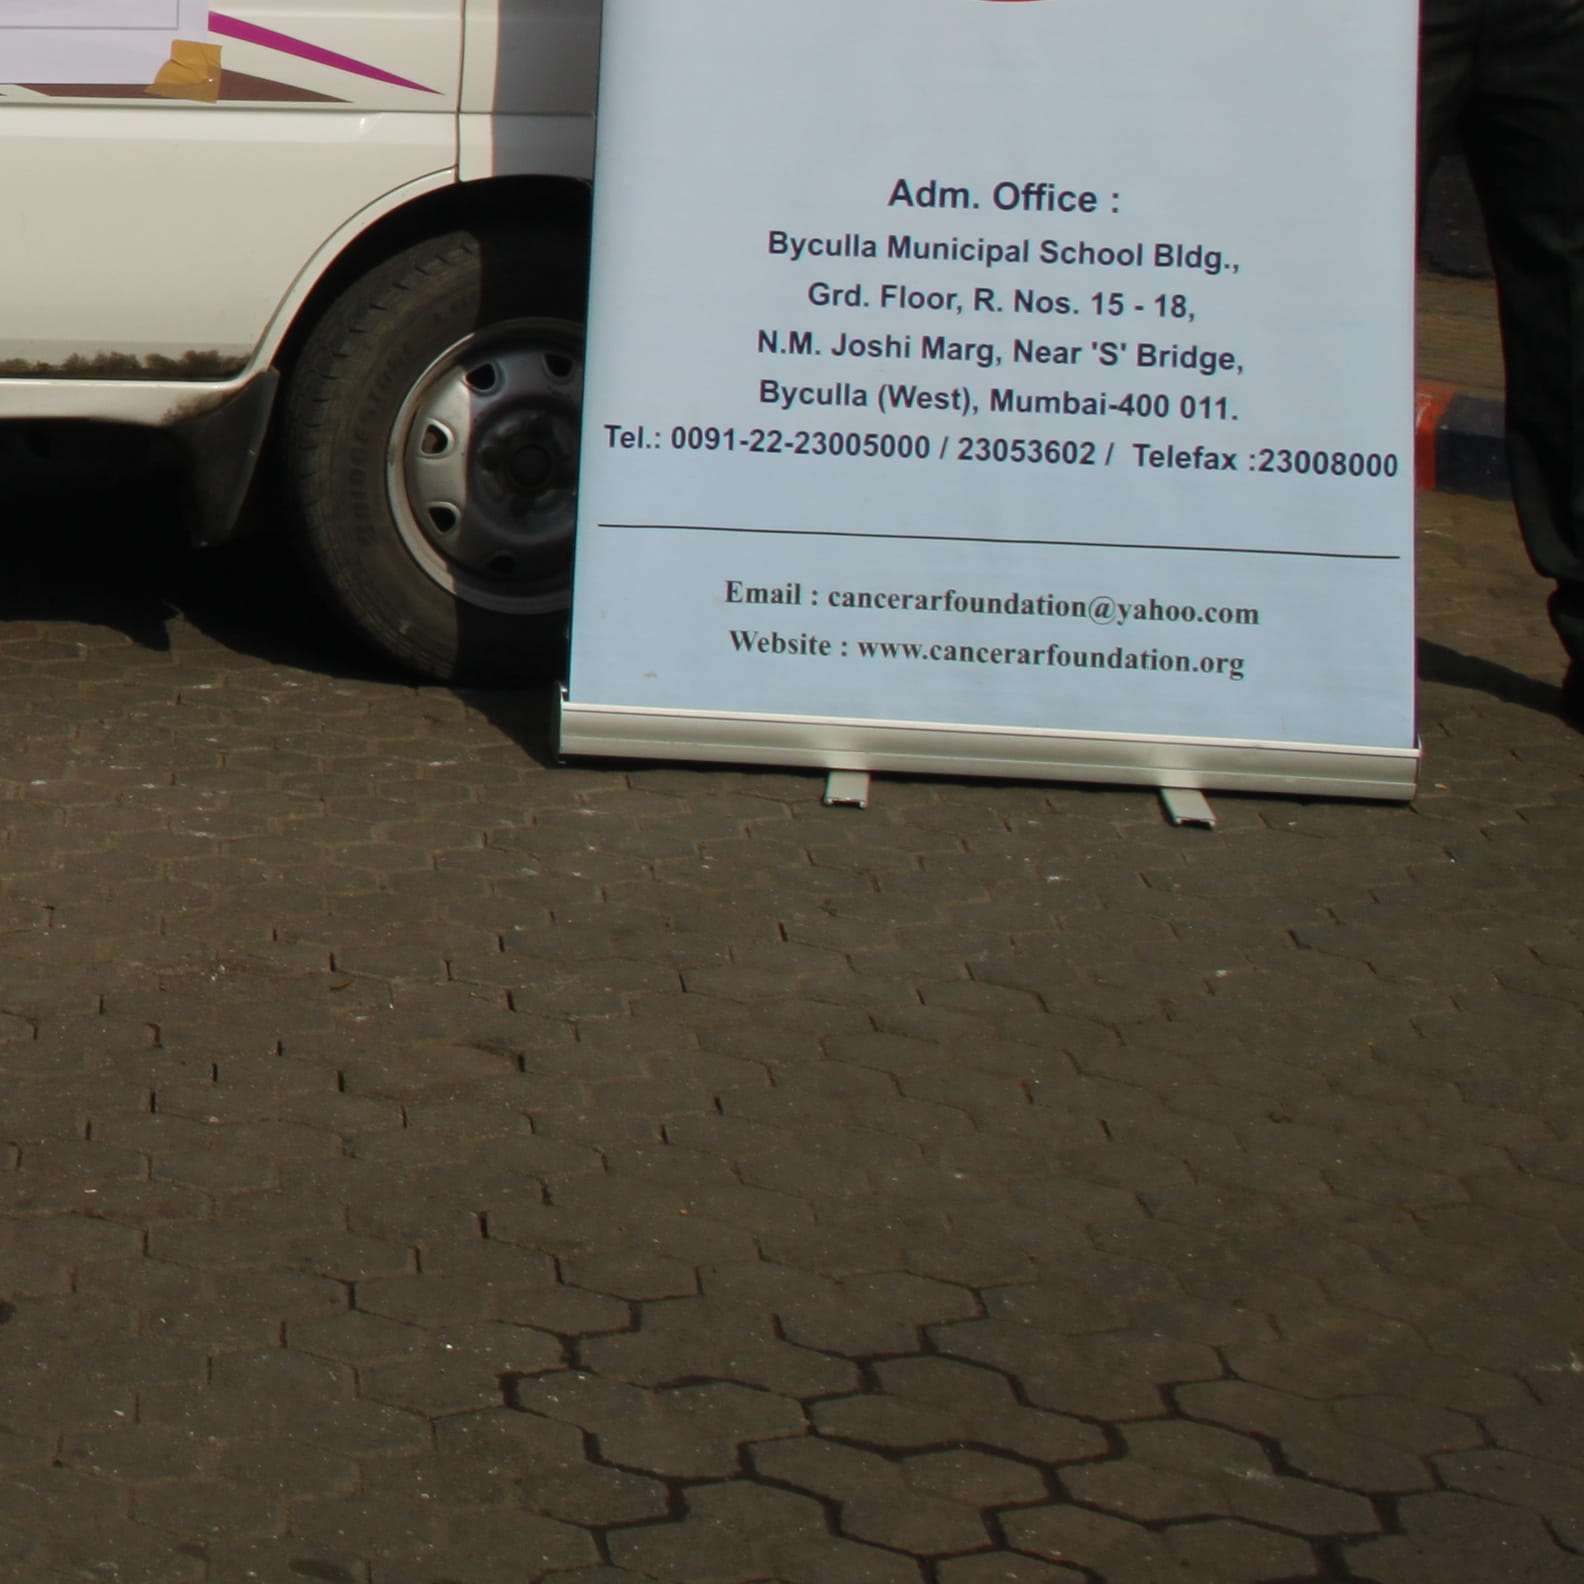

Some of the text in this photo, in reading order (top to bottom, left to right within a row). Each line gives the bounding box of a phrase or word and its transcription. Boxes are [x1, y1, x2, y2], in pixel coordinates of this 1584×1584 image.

[888, 179, 1098, 214] Adm. Office
[769, 231, 1240, 277] Byculla Municipal School Bldg.,
[760, 379, 1239, 422] Byculla (West), Mumbai-400 011.
[604, 424, 662, 450] Tel.:
[672, 426, 931, 460] 0091-22-23005000
[958, 437, 1097, 466] 23053602
[1133, 444, 1238, 472] Telefax
[726, 581, 1260, 627] Email cancerarfoundation@yahoo.com
[730, 630, 1245, 681] Website www.cancerarfoundation.org
